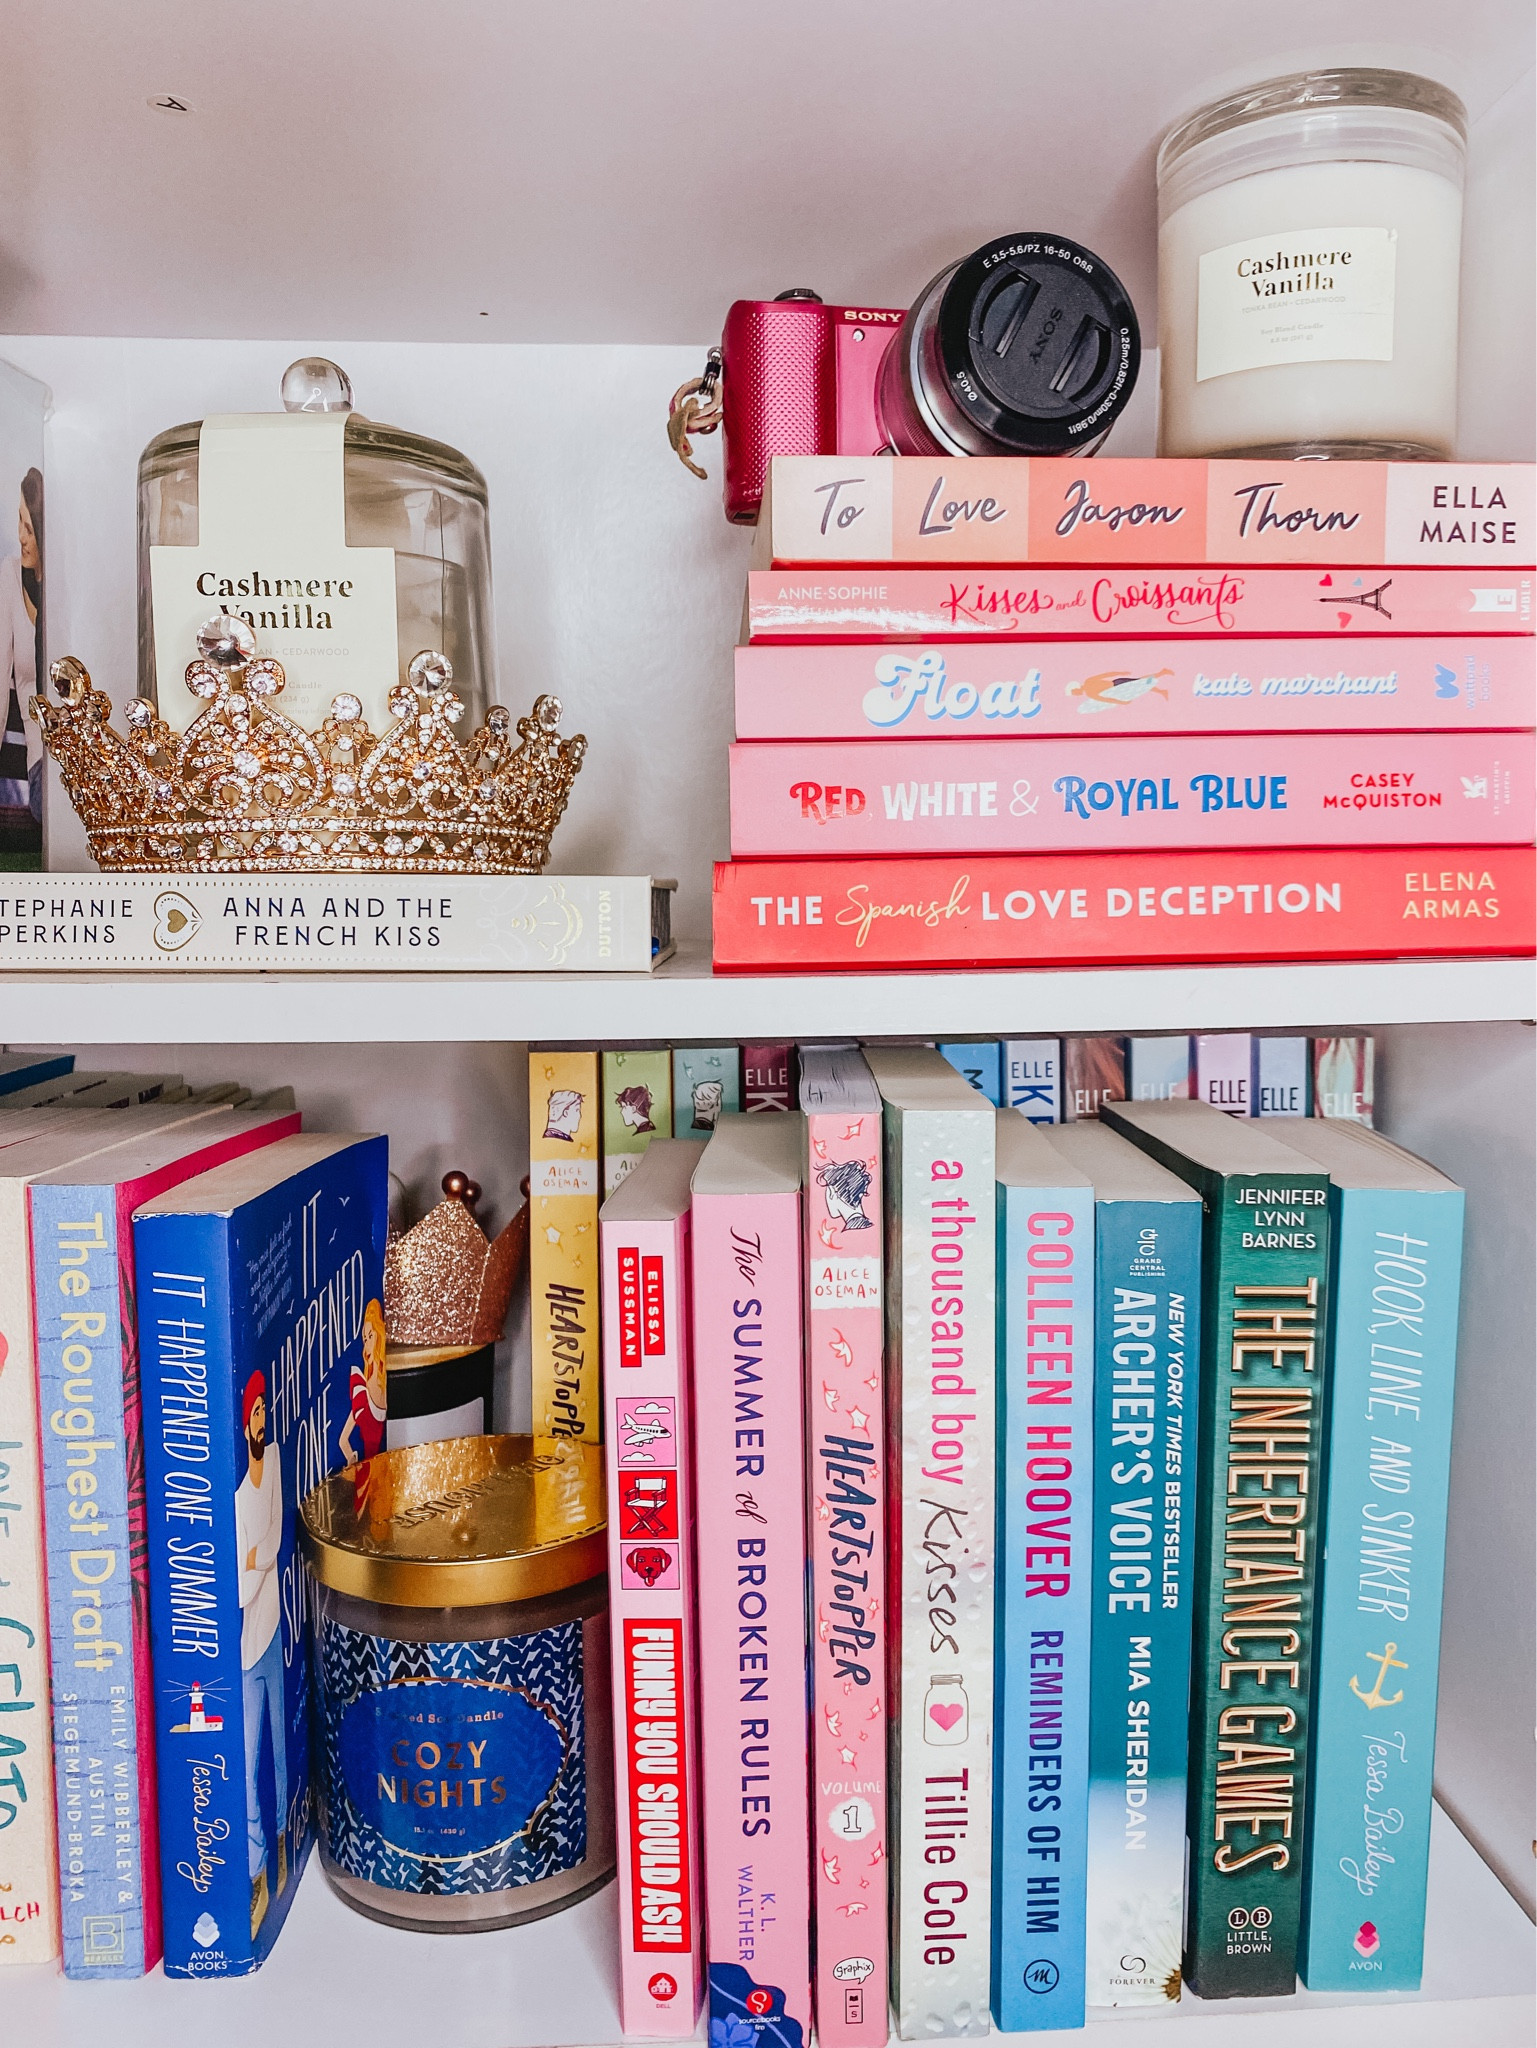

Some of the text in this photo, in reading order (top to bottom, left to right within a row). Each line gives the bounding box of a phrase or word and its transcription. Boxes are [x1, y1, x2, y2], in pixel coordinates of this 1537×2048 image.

[1044, 245, 1071, 261] 16-50
[1236, 248, 1353, 278] Cashmere
[1251, 271, 1335, 299] Vanilla
[843, 311, 902, 323] SONY
[1029, 307, 1064, 365] SONY
[814, 476, 1363, 539] To Love Jason Thorn
[1433, 485, 1508, 510] ELLA
[1419, 520, 1517, 544] MAISE
[196, 571, 354, 598] Cashmere
[777, 586, 889, 601] ANNE-SOPHIE
[940, 574, 1245, 631] Kisses and Croissants
[1519, 579, 1532, 622] EMBER
[219, 603, 333, 630] Vanilla
[282, 647, 350, 657] CEDARWOOD
[863, 650, 1043, 728] Float
[1192, 670, 1398, 698] kate marchant
[1464, 655, 1477, 711] wattpad
[1479, 663, 1492, 703] books
[1350, 772, 1416, 789] CASEY
[881, 779, 998, 822] WHITE
[1008, 779, 1040, 818] &
[1052, 774, 1179, 820] ROYAL
[1189, 774, 1289, 814] BLUE
[1404, 871, 1496, 893] ELENA
[222, 898, 454, 919] ANNA AND THE
[597, 889, 612, 958] DUTTON
[750, 874, 1342, 948] THE Spanish LOVE DECEPTION
[1402, 897, 1501, 920] ARMAS
[0, 925, 117, 944] PERKINS
[234, 925, 443, 948] FRENCH KISS
[745, 1068, 788, 1087] ELLE
[1011, 1060, 1054, 1079] ELLE
[1074, 1088, 1113, 1114] ELLE
[1209, 1079, 1247, 1104] ELLE
[1260, 1086, 1299, 1112] ELLE
[1324, 1091, 1364, 1117] ELLE
[542, 1177, 589, 1189] OSEMAN
[548, 1166, 583, 1177] ALICE
[1235, 1188, 1327, 1206] JENNIFER
[1254, 1210, 1306, 1227] LYNN
[302, 1189, 322, 1300] IT
[1241, 1232, 1317, 1250] BARNES
[822, 1267, 871, 1282] ALICE
[814, 1283, 879, 1299] OSEMAN
[622, 1256, 637, 1357] SUSSMAN
[647, 1270, 659, 1346] ELISSA
[270, 1249, 364, 1446] HAPPENED
[544, 1283, 587, 1441] HEARTSTOPPE
[919, 1160, 977, 1656] a thousand boy Kisses
[1024, 1211, 1075, 1599] COLLEEN HOOVER
[50, 1212, 125, 1672] The Roughest Draft
[1355, 1231, 1430, 1624] HOOK, LINE, AND SINKER
[296, 1387, 333, 1508] ONE
[1108, 1287, 1157, 1614] ARCHER'S VOICE
[1161, 1291, 1186, 1610] NEW YORK TIMES BESTSELLER
[151, 1270, 220, 1660] IT HAPPENED ONE SUMMER
[730, 1226, 772, 1838] The SUMMER of BROKEN RULES
[819, 1434, 877, 1687] HEARTSTOPPER
[1213, 1276, 1319, 1874] THE INHERITANCE GAMES
[391, 1739, 488, 1770] COZY
[1124, 1635, 1153, 1851] MIA SHERIDAN
[61, 1692, 86, 1903] SIEGEMUND-BROKA
[87, 1757, 107, 1838] AUSTIN
[110, 1685, 136, 1904] EMILY WIBBERLEY &
[377, 1772, 507, 1809] NIGHTS
[630, 1627, 684, 1945] FUNNY YOU SHOULD ASK
[821, 1780, 882, 1796] VOLUME
[1026, 1630, 1065, 1935] REMINDERS OF HIM
[176, 1753, 231, 1894] Tessa Bailey
[842, 1805, 862, 1834] 1
[1339, 1731, 1408, 1897] Tessa Bailey
[923, 1767, 969, 1966] Tillie Cole
[737, 1864, 756, 1962] WALTHER
[760, 1892, 777, 1934] K. L.
[1226, 1930, 1273, 1943] LITTLE,
[1226, 1943, 1273, 1955] BROWN
[187, 1961, 228, 1972] BOOKS
[189, 1950, 224, 1961] AVON
[835, 1961, 872, 1978] graphix
[1348, 1961, 1384, 1972] AVON
[1109, 1978, 1156, 1986] FOREVER
